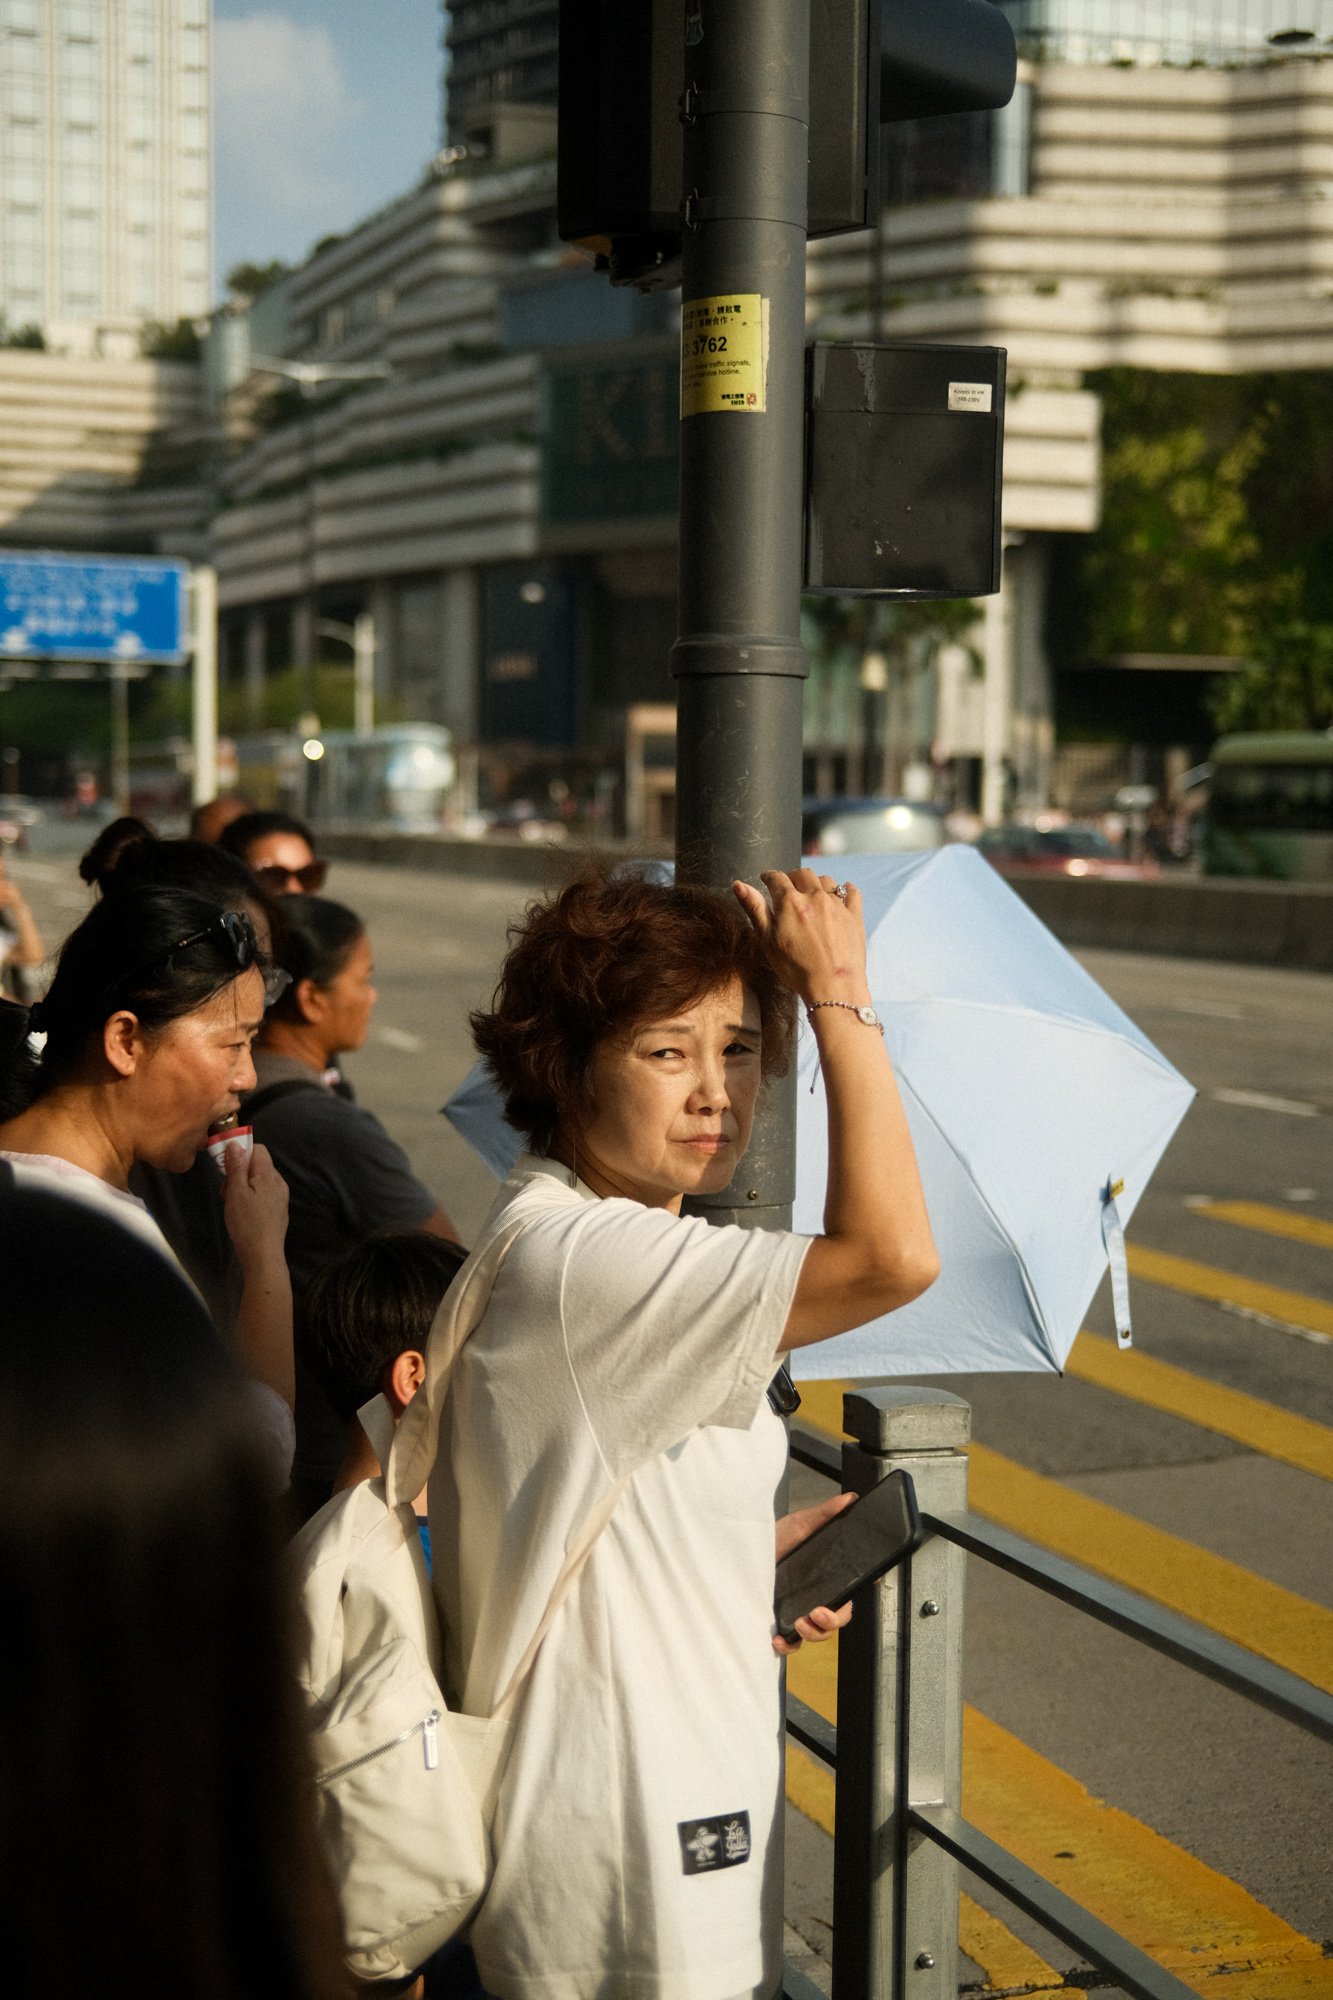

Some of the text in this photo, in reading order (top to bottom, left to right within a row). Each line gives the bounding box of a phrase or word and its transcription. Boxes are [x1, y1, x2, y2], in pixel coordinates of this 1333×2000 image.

[692, 336, 728, 356] 3762
[726, 360, 751, 368] signals,
[724, 1820, 745, 1840] La
